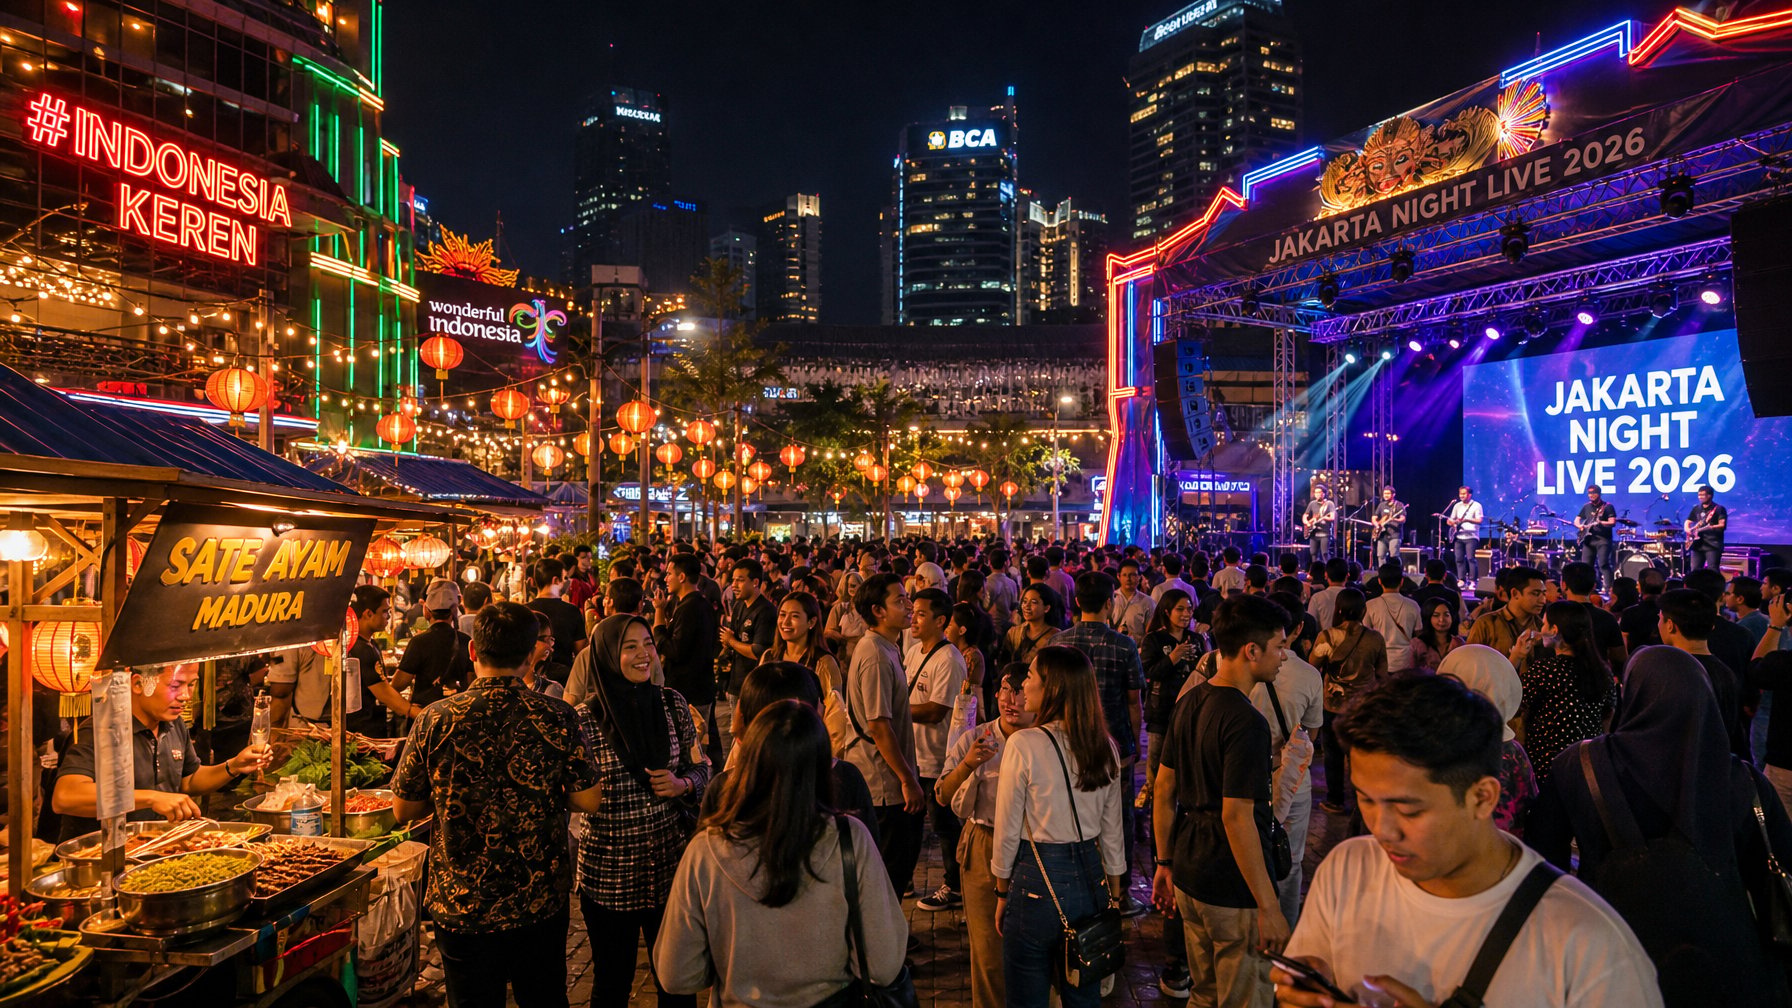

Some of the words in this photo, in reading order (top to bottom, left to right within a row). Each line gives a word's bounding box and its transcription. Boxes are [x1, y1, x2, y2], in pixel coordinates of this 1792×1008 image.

[27, 92, 292, 228] #INDONESIA
[948, 129, 997, 148] BCA
[1268, 210, 1383, 264] JAKARTA
[1391, 179, 1477, 229] NIGHT
[1486, 156, 1552, 200] LIVE
[1563, 126, 1646, 177] 2026
[119, 182, 257, 266] KEREN
[429, 300, 506, 323] wonderful
[1544, 364, 1726, 416] JAKARTA
[1569, 410, 1698, 454] NIGHT
[1536, 458, 1617, 495] LIVE
[1627, 453, 1737, 494] 2026
[159, 536, 264, 587] SATE
[262, 538, 352, 582] AYAM
[191, 590, 305, 634] MADURA
